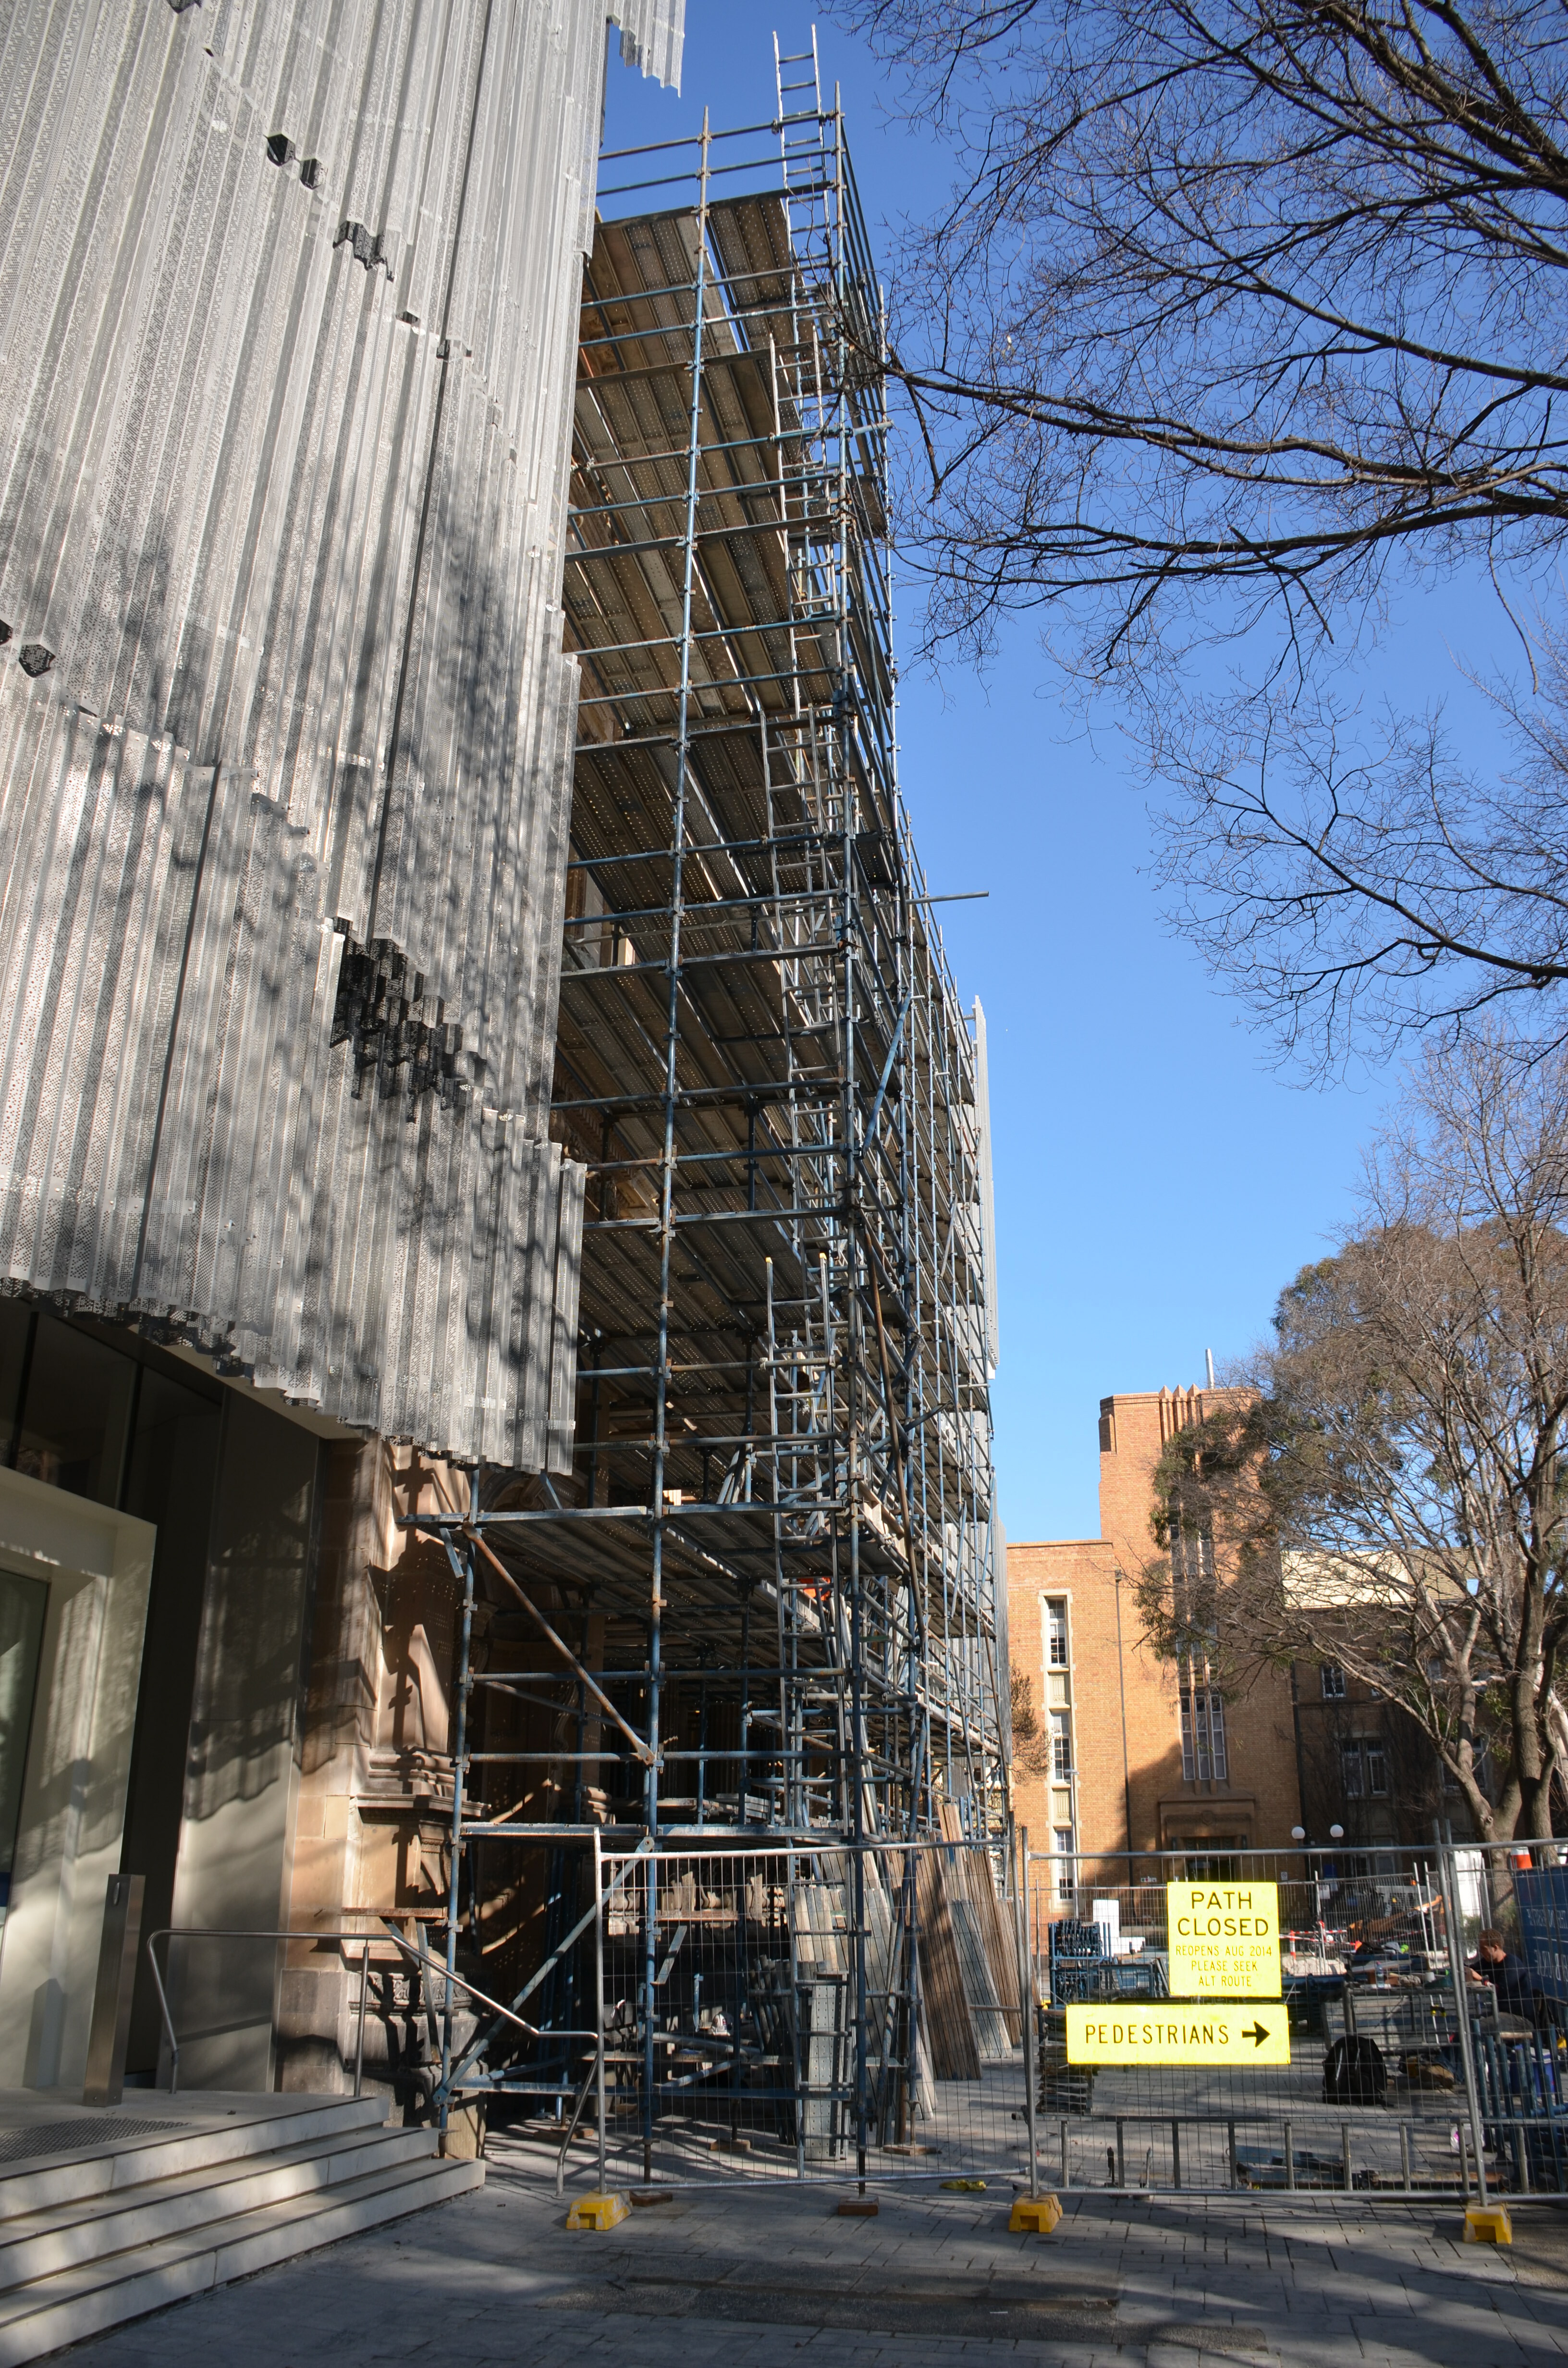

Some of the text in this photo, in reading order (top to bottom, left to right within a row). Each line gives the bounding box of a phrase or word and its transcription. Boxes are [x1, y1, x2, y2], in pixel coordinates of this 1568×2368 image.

[1192, 1892, 1252, 1910] PATH
[1178, 1919, 1269, 1936] CLOSED
[1176, 1946, 1272, 1957] REOPENS AUG 2014
[1192, 1961, 1258, 1972] PLEASE SEEK
[1199, 1976, 1252, 1987] ALT ROUTE
[1086, 2025, 1229, 2045] PEDESTRIANS
